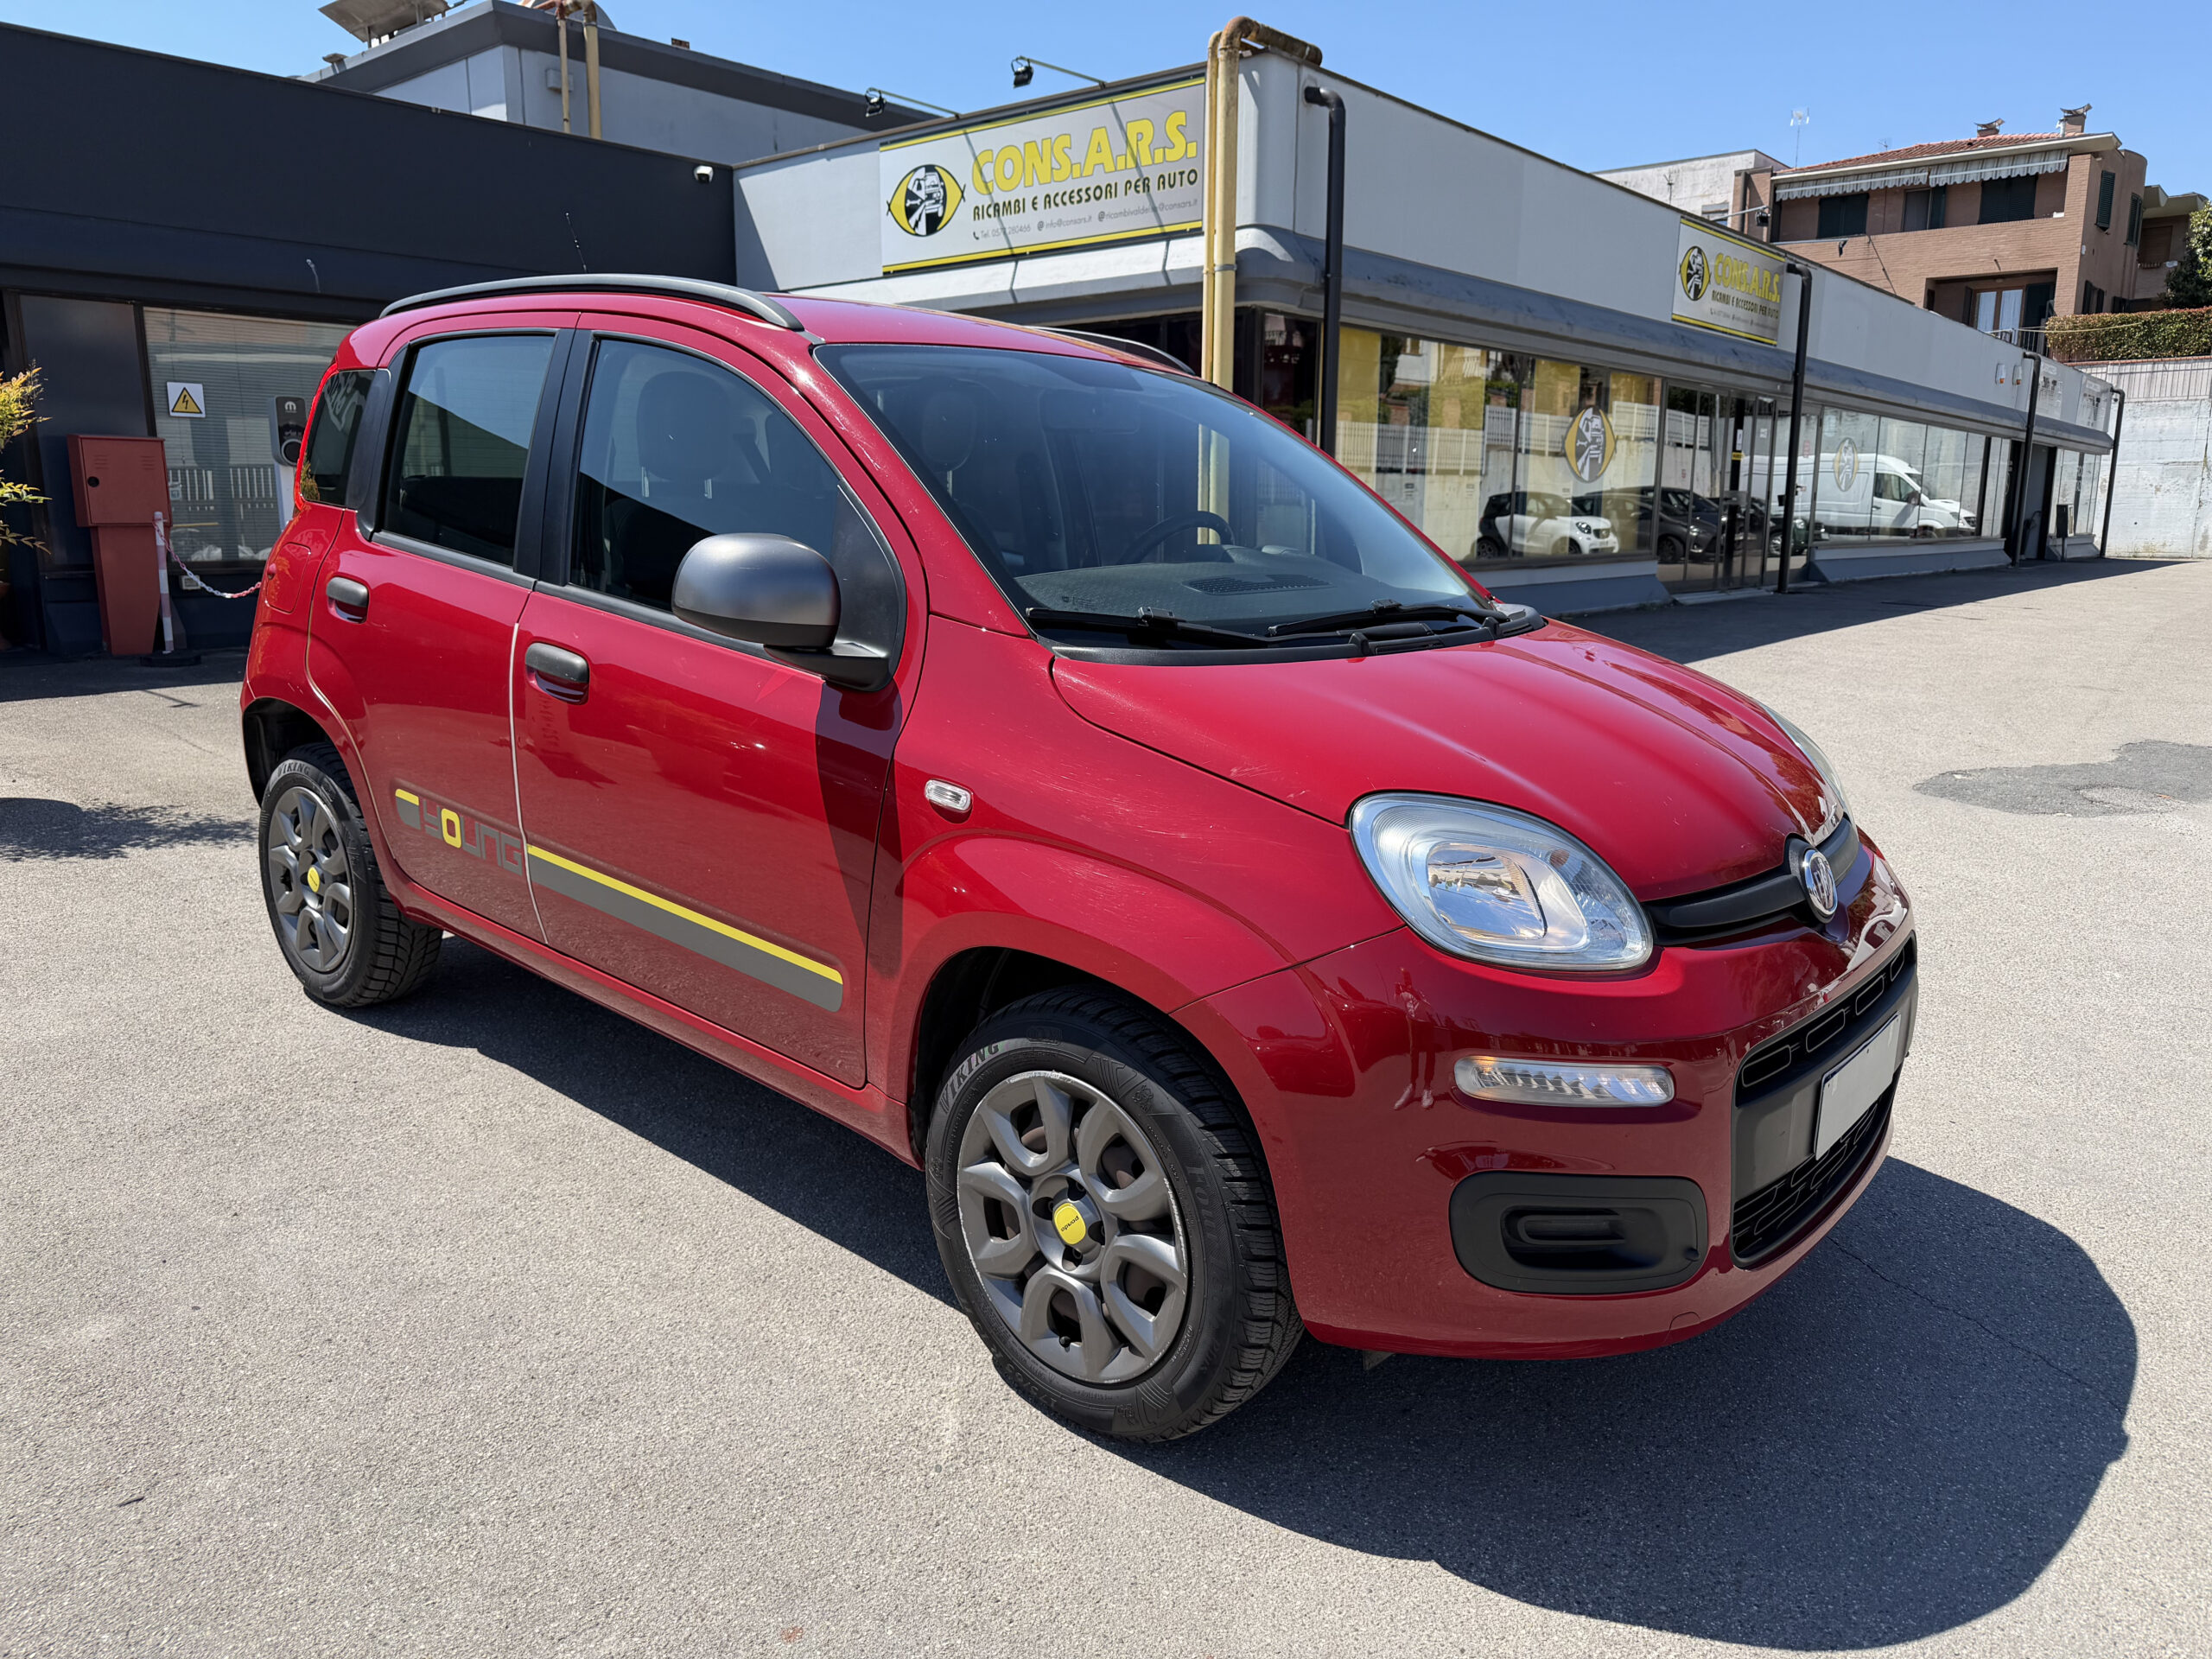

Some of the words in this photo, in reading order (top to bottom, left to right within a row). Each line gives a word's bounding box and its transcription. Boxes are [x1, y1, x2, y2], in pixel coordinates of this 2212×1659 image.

[972, 111, 1198, 195] CONS.A.R.S.
[973, 197, 1026, 221] RICAMBI
[1031, 195, 1039, 211] E
[1044, 181, 1118, 210] ACCESSORI
[1124, 176, 1151, 196] PER
[1157, 168, 1198, 191] AUTO
[1712, 289, 1731, 305] RICAMBI
[1735, 297, 1758, 313] ACCESSORI
[1714, 253, 1780, 303] CONS.A.R.S.
[276, 762, 311, 778] VIKING
[940, 1043, 1000, 1114] VIKING
